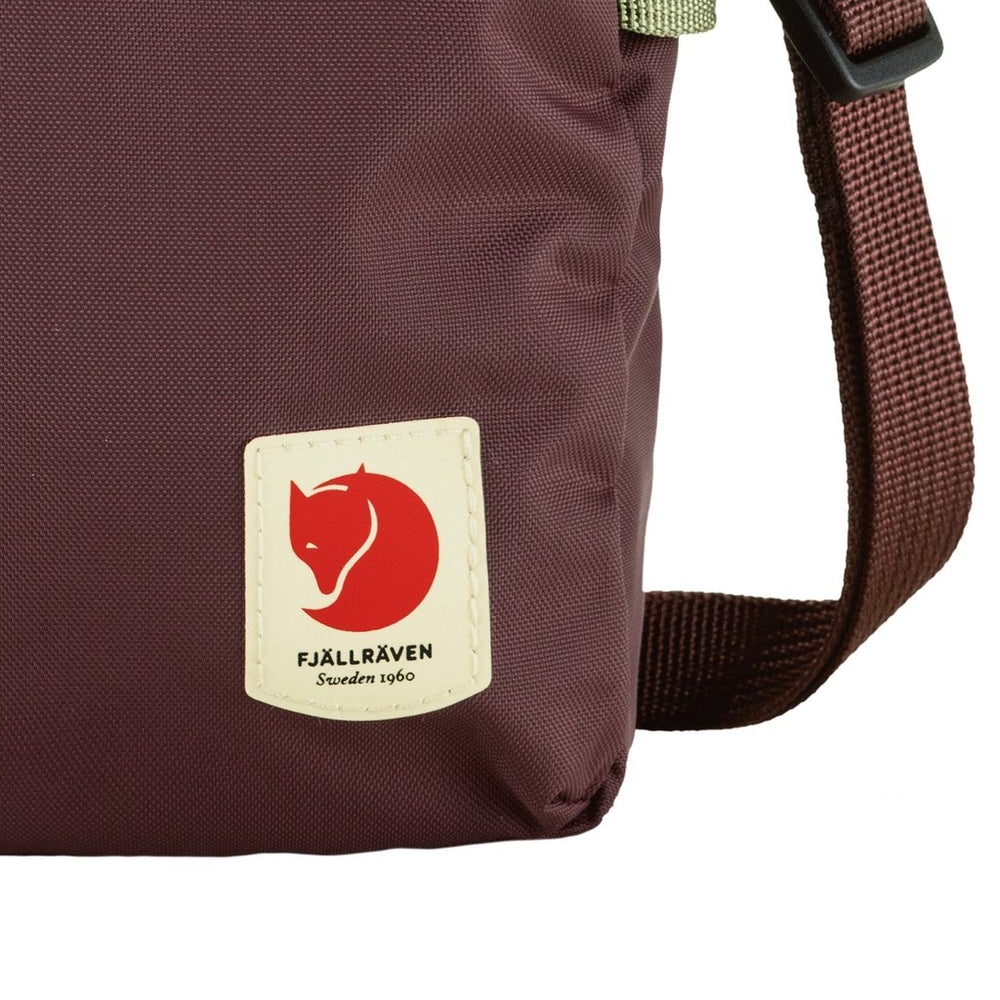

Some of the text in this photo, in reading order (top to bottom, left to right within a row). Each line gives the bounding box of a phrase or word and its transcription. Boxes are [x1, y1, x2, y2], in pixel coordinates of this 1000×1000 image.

[297, 643, 433, 668] FJÄLLRÄVEN
[316, 668, 416, 687] Sweden 1960
